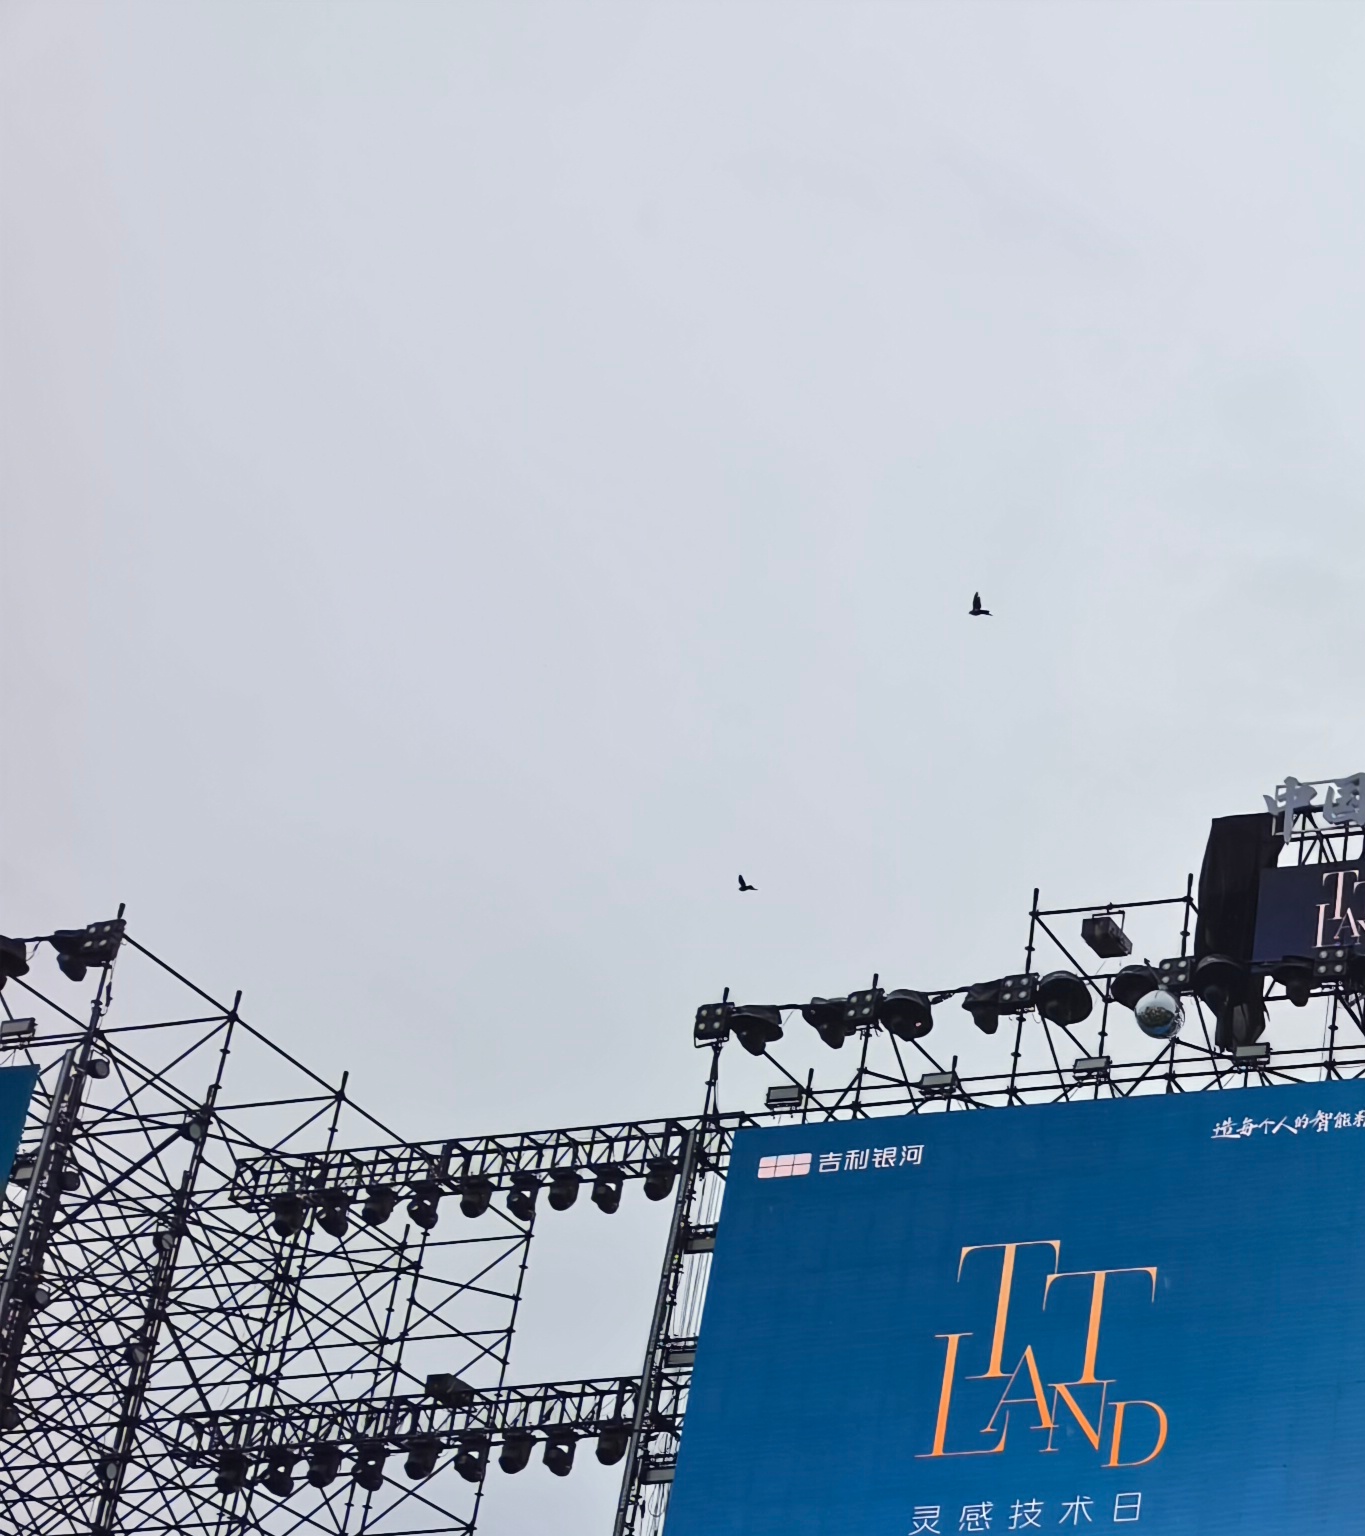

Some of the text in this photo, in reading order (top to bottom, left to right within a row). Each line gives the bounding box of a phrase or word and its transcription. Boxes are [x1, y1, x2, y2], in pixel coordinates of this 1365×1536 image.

[818, 1144, 925, 1173] 吉利银河
[915, 1332, 1168, 1468] LAND
[908, 1492, 1142, 1536] 灵感技术日
